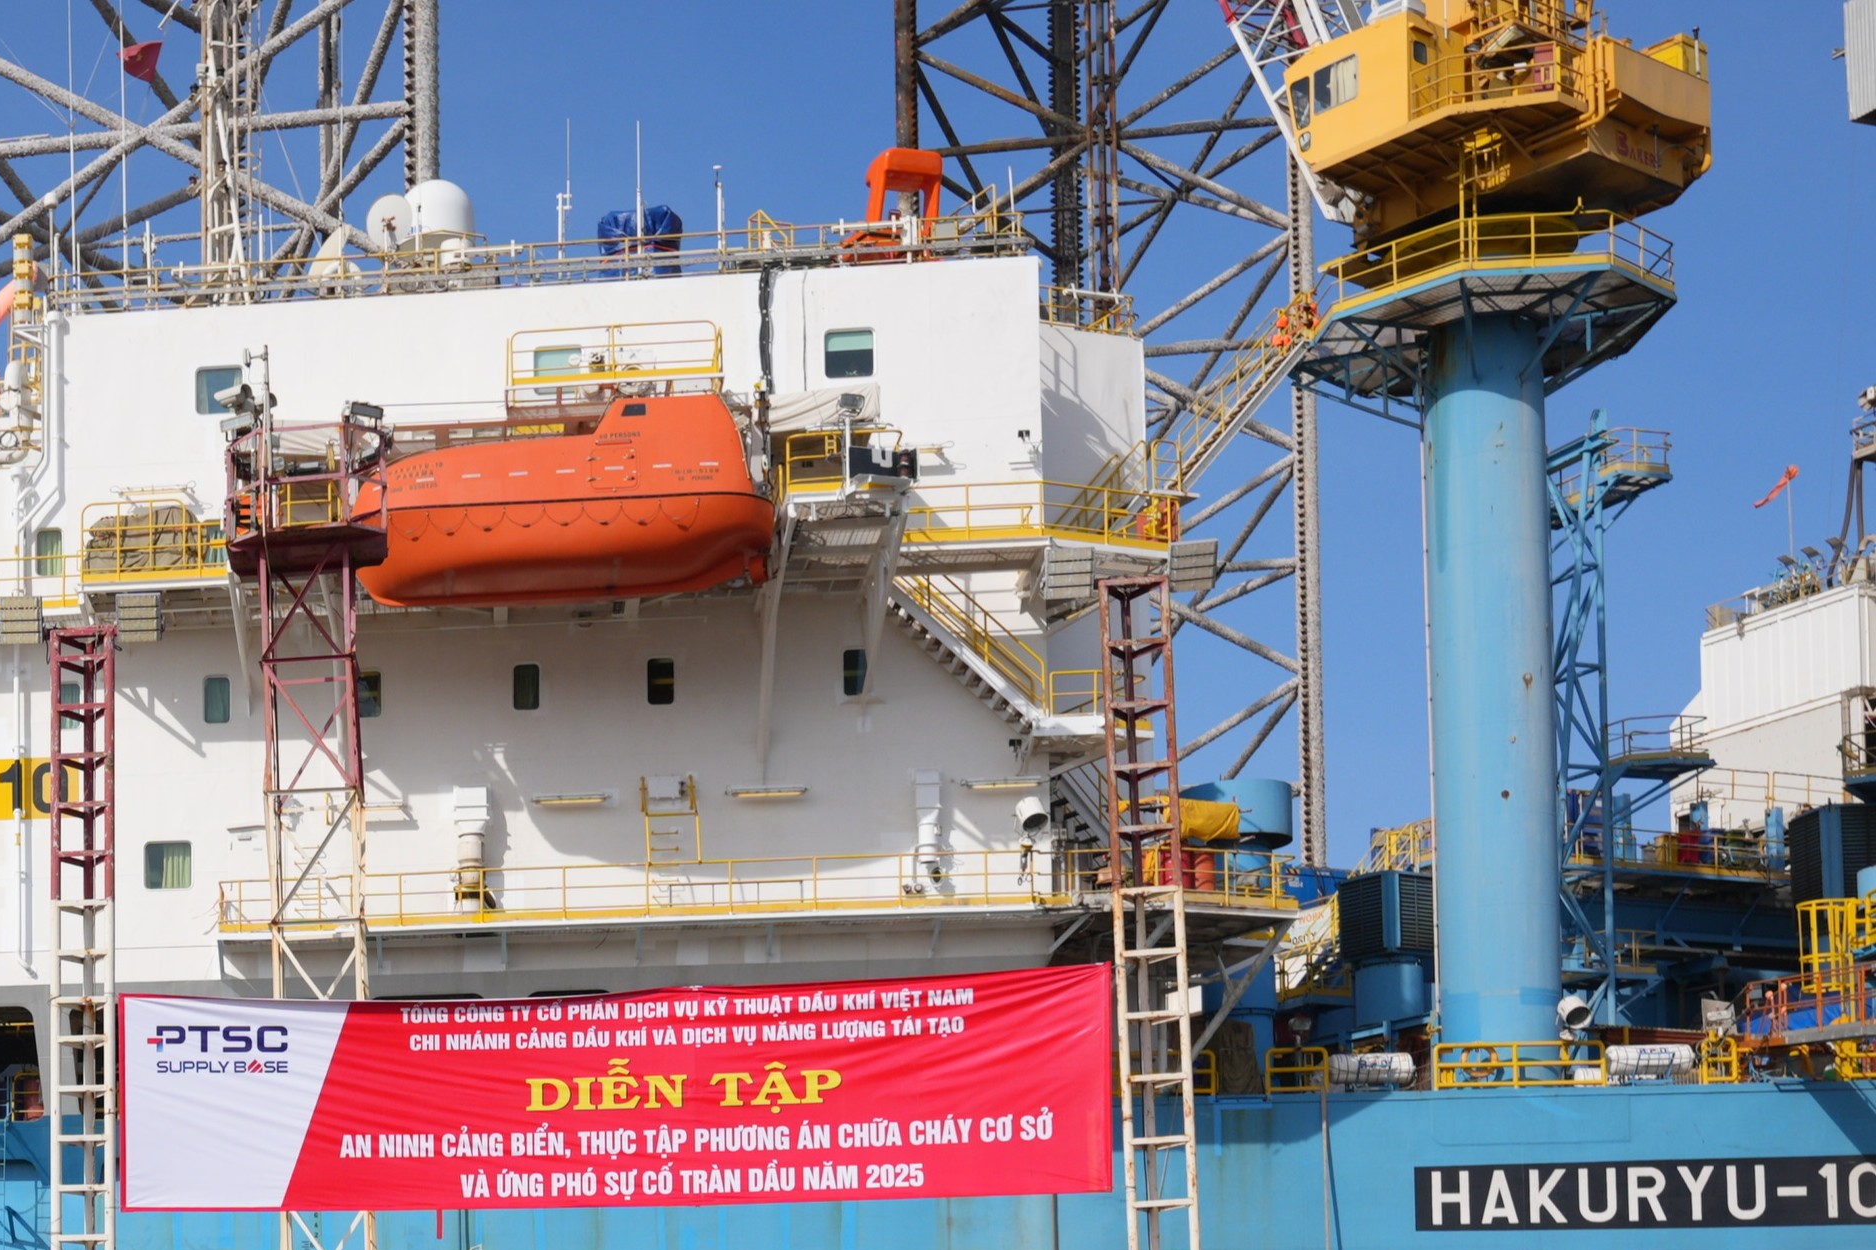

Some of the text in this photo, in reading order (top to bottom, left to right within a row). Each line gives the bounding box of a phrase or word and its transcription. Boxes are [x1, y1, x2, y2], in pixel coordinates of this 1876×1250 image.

[510, 1005, 531, 1022] TY
[624, 1001, 668, 1023] DỊCH
[674, 1000, 698, 1020] VỤ
[735, 994, 793, 1018] THUẬT
[798, 991, 837, 1012] DẦU
[843, 989, 875, 1010] KHÍ
[881, 988, 922, 1011] VIỆT
[927, 988, 974, 1006] NAM
[147, 1025, 288, 1053] PTSC
[409, 1015, 964, 1051] CHI NHÁNH CẢNG DẦU KHÍ VÀ DỊCH VỤ NĂNG LƯỢNG TÁI TẠO
[156, 1060, 229, 1074] SUPPLY
[525, 1057, 843, 1114] DIỄN TẬP
[339, 1106, 1054, 1160] AN NINH CẢNG BIỂN, THỰC TẬP PHƯƠNG ÁN CHỮA CHÁY CƠ SỞ
[460, 1159, 925, 1200] VÀ ỨNG PHÓ SỰ CỐ TRÀN DẦU NĂM 2025
[1430, 1162, 1876, 1226] HAKURYU-10
